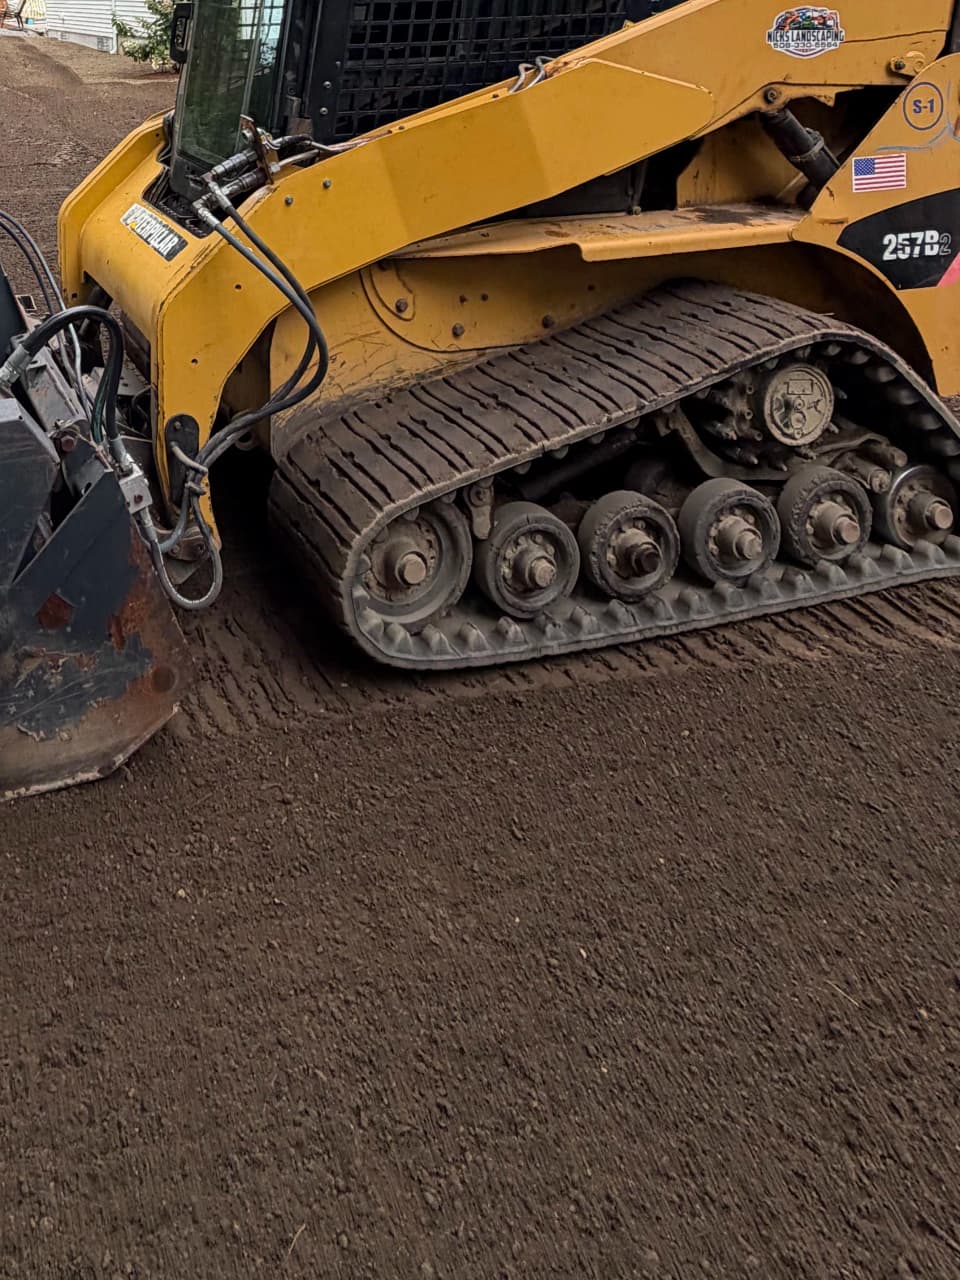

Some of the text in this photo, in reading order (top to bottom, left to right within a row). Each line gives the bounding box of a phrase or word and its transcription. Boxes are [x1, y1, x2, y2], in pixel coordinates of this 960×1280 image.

[768, 30, 844, 42] NICKS LANDSCAPING
[913, 98, 935, 114] S-1
